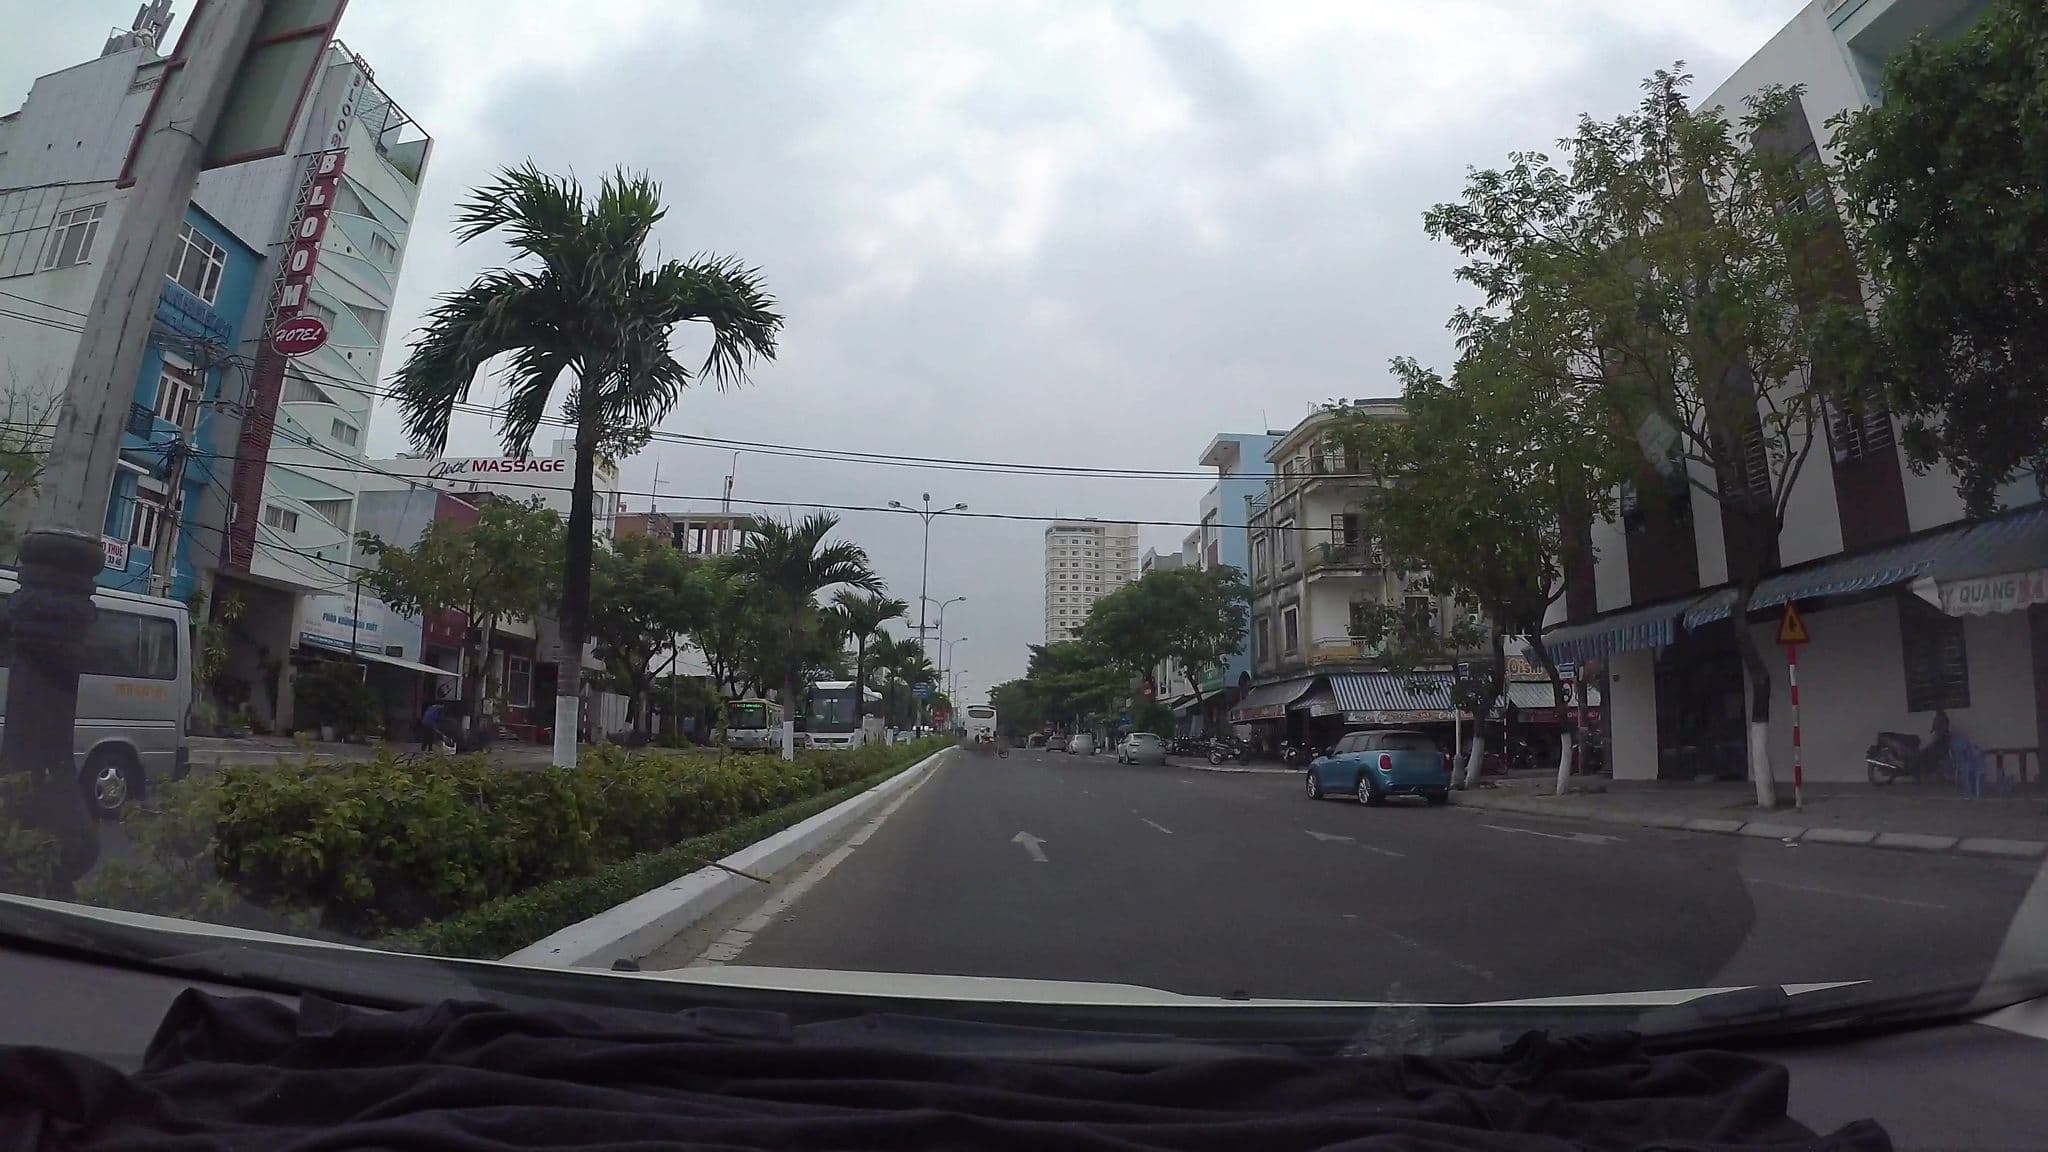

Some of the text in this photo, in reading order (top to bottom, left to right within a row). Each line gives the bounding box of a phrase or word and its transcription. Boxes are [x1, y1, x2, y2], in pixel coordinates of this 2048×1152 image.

[282, 154, 337, 306] BLOOM
[275, 327, 323, 343] HOTEL
[472, 459, 566, 473] MASSAGE
